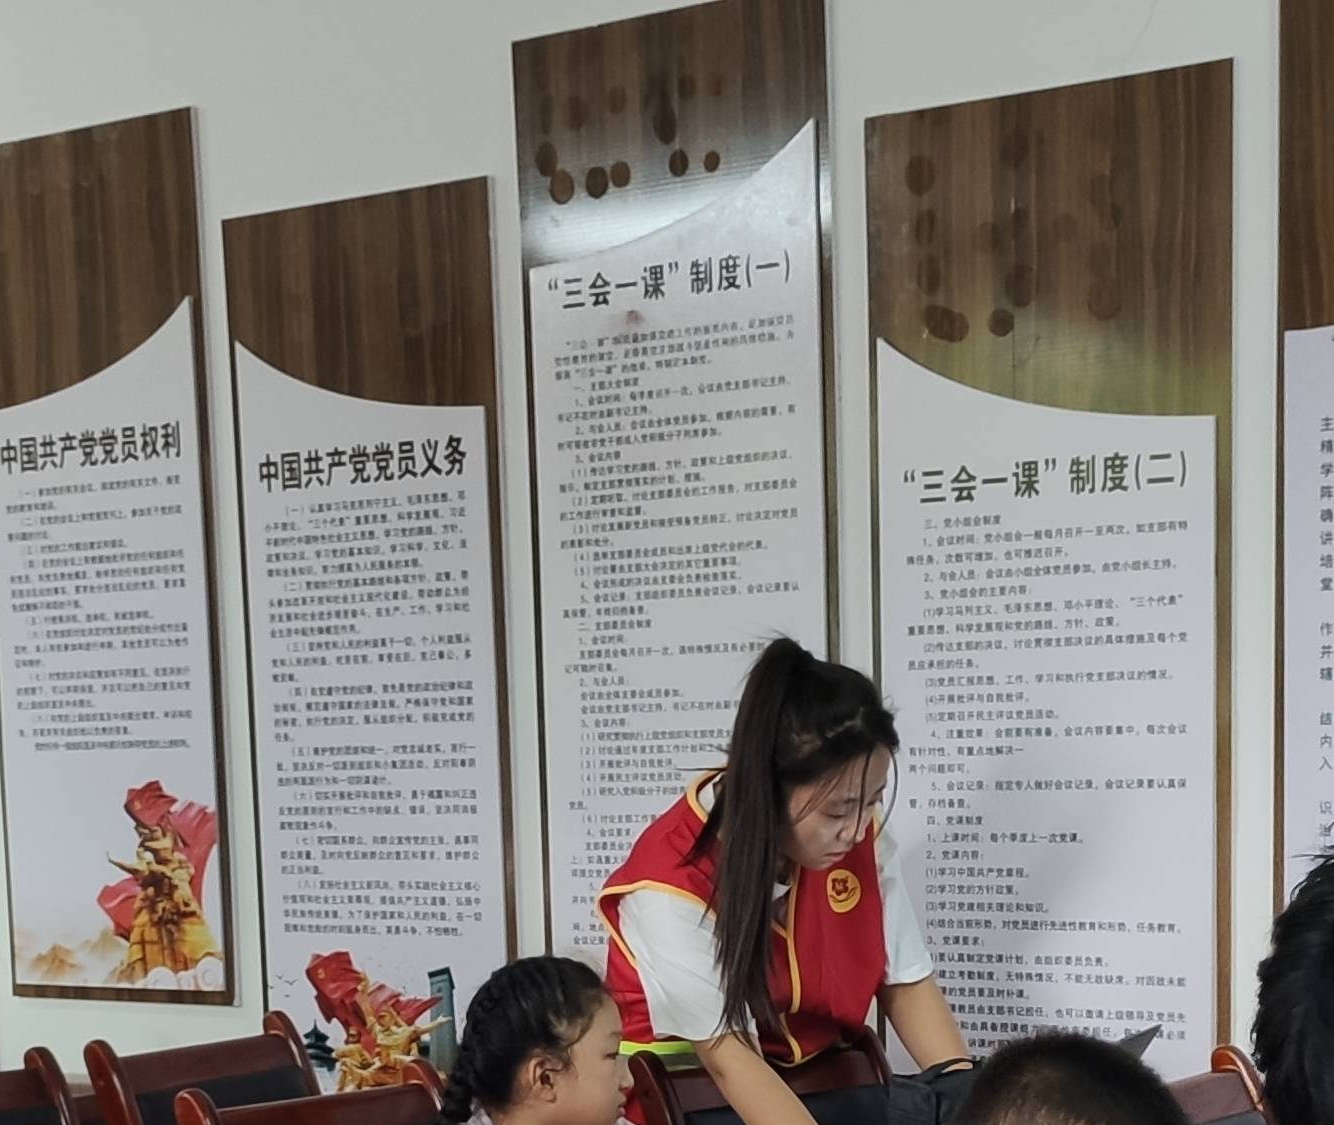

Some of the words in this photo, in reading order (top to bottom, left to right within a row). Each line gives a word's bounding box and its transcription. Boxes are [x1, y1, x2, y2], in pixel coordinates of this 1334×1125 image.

[0, 420, 181, 475] 中国共产党党员权利
[258, 434, 467, 493] 中国共产党党员义务
